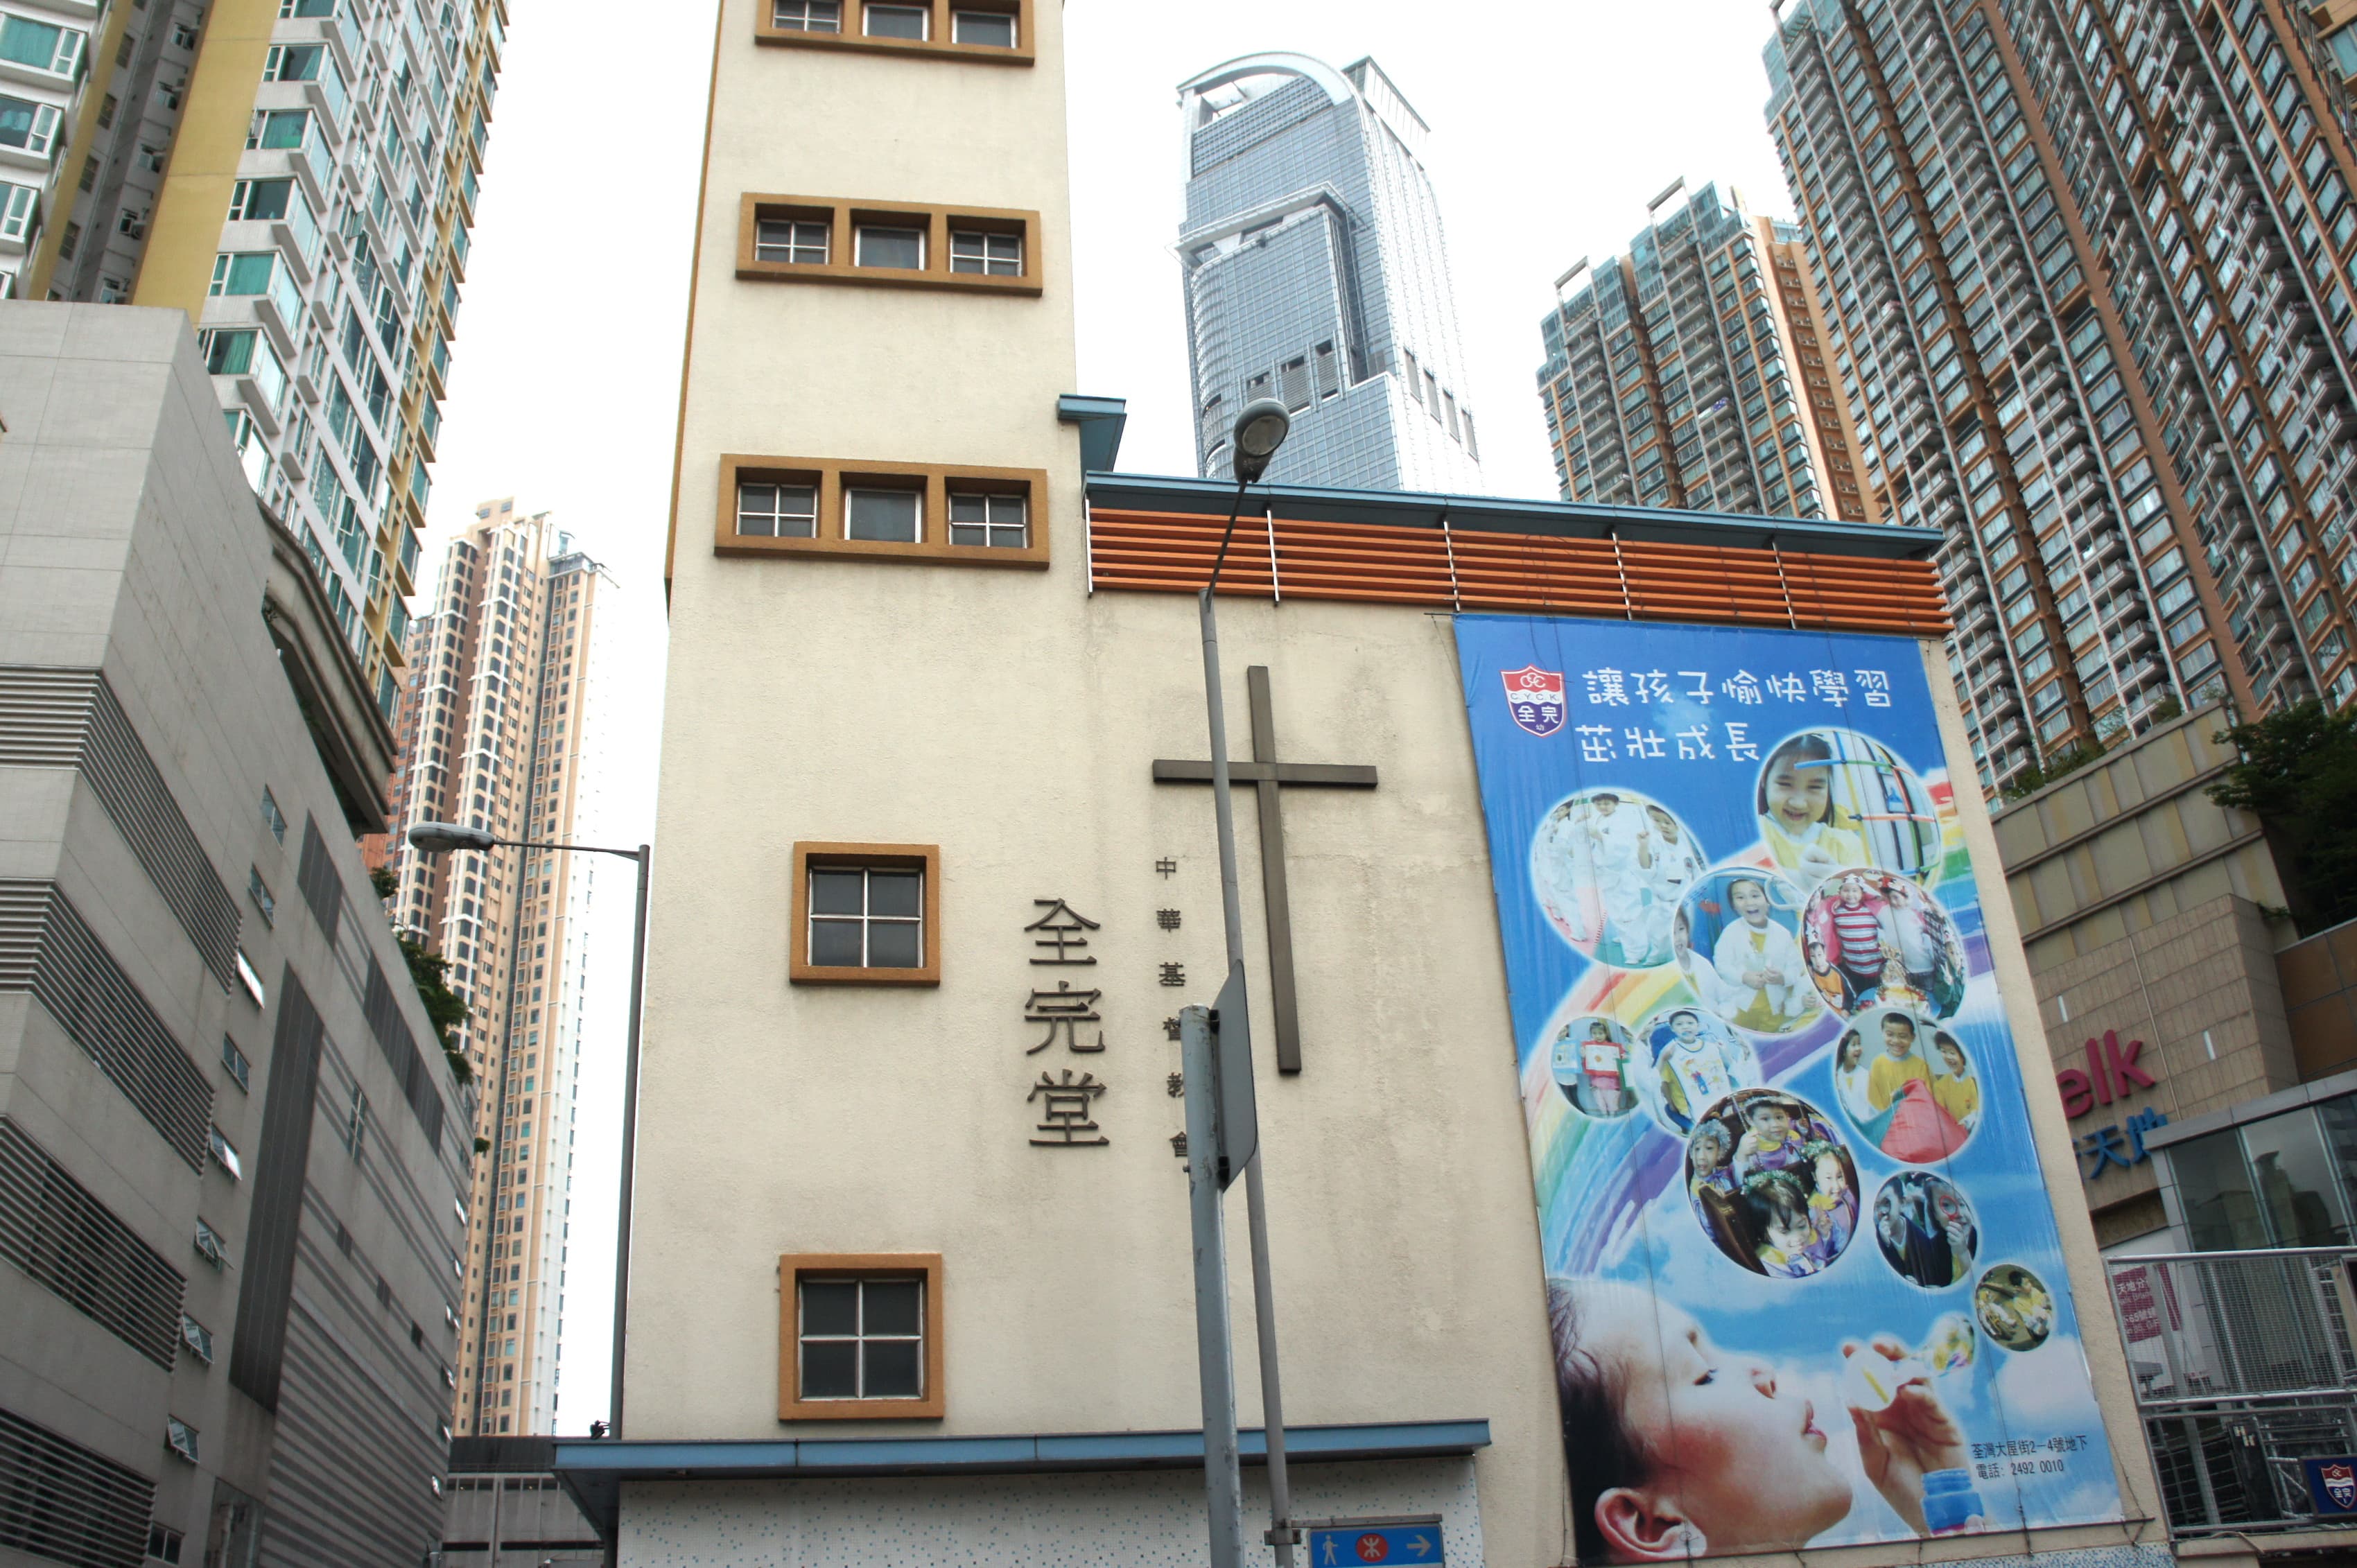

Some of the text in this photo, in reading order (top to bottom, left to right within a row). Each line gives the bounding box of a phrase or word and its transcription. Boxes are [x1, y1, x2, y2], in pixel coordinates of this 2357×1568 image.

[1581, 667, 1892, 708] 讓孩子愉快學習
[1517, 705, 1559, 724] 全完
[1574, 722, 1760, 763] 茁壯成長
[1024, 897, 1110, 1147] 全完堂
[2010, 1461, 2035, 1476] 2492
[2039, 1458, 2064, 1473] 0010
